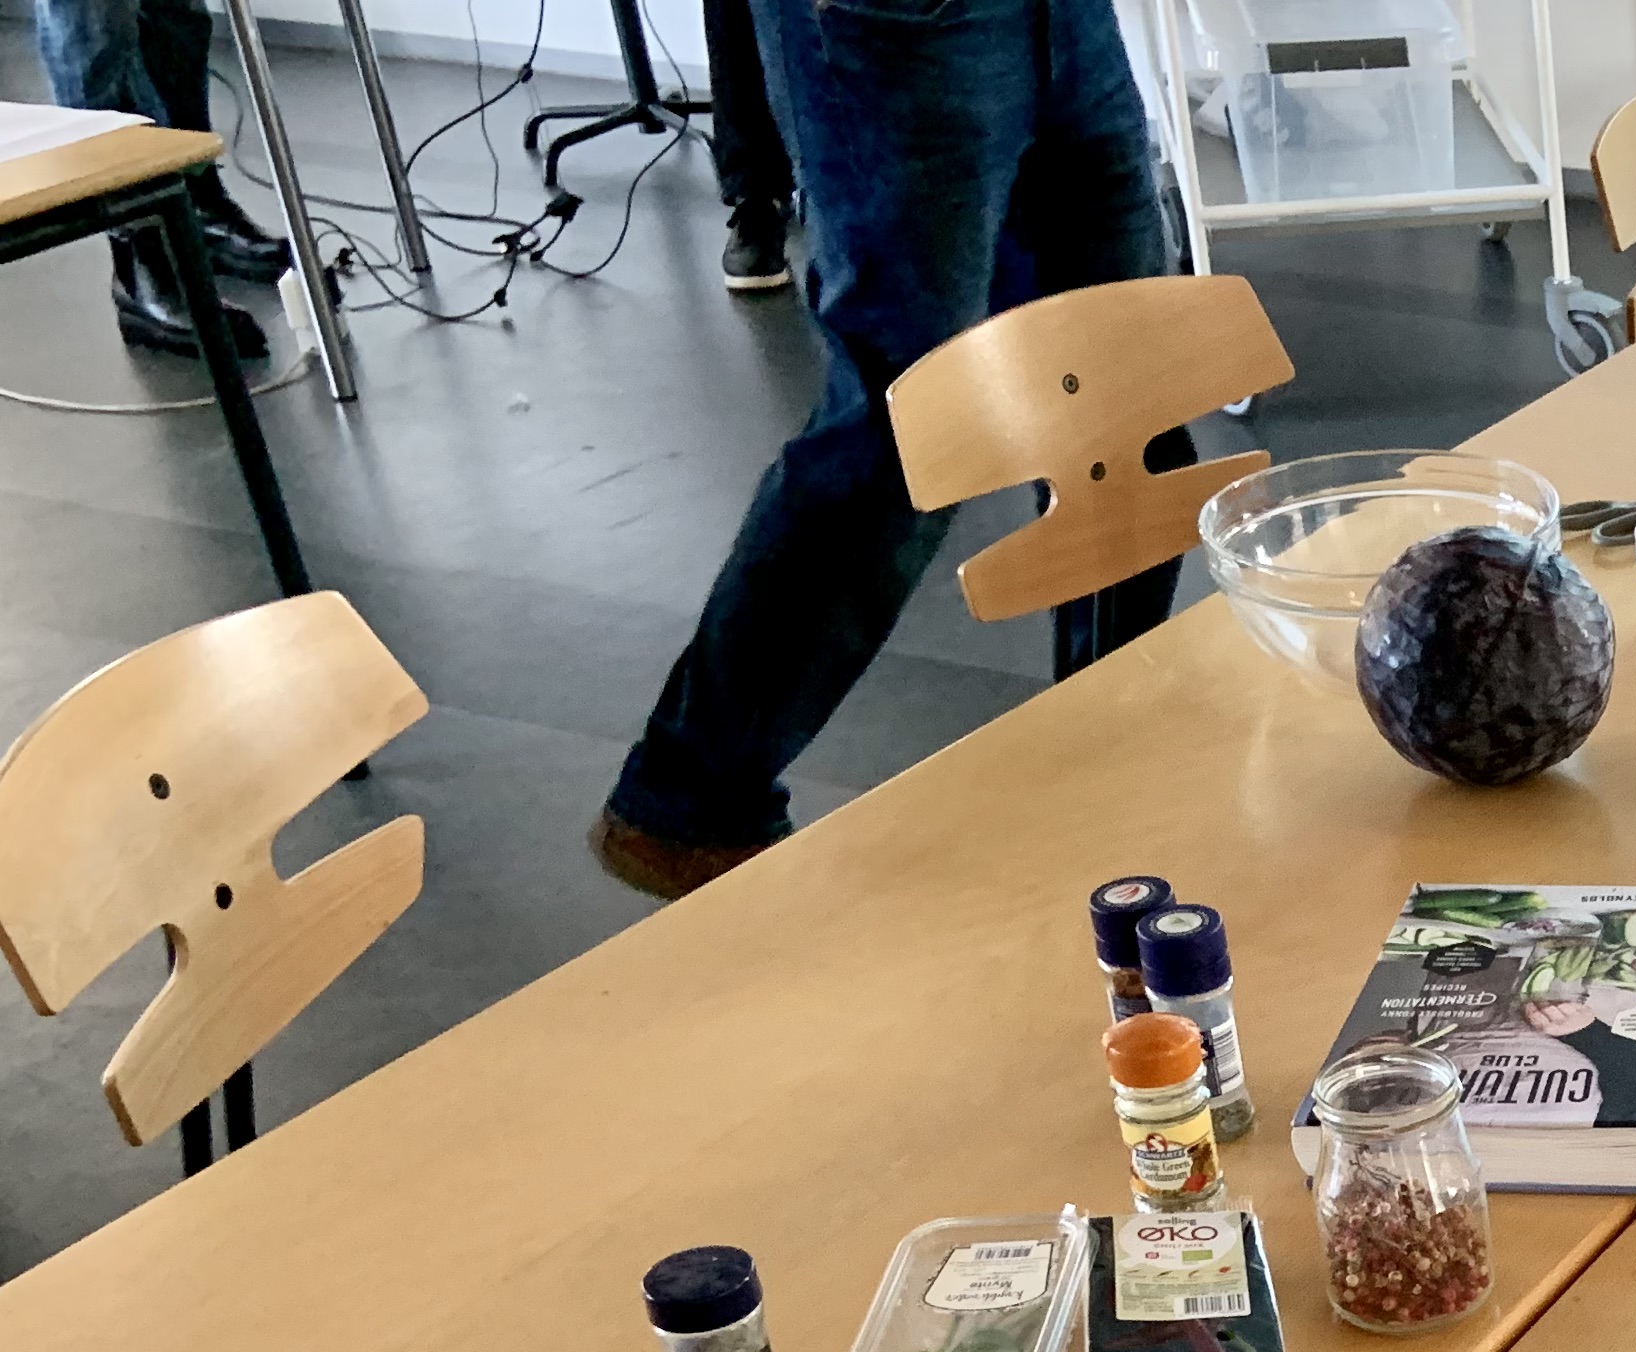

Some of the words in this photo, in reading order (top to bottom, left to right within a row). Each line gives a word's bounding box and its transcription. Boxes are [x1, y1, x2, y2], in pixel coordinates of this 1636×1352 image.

[1422, 983, 1468, 993] RECIPES
[1380, 990, 1498, 1010] FERMENTATION
[1479, 1054, 1540, 1068] CLUB
[1162, 1159, 1191, 1172] Green
[1137, 1225, 1219, 1242] ØKO
